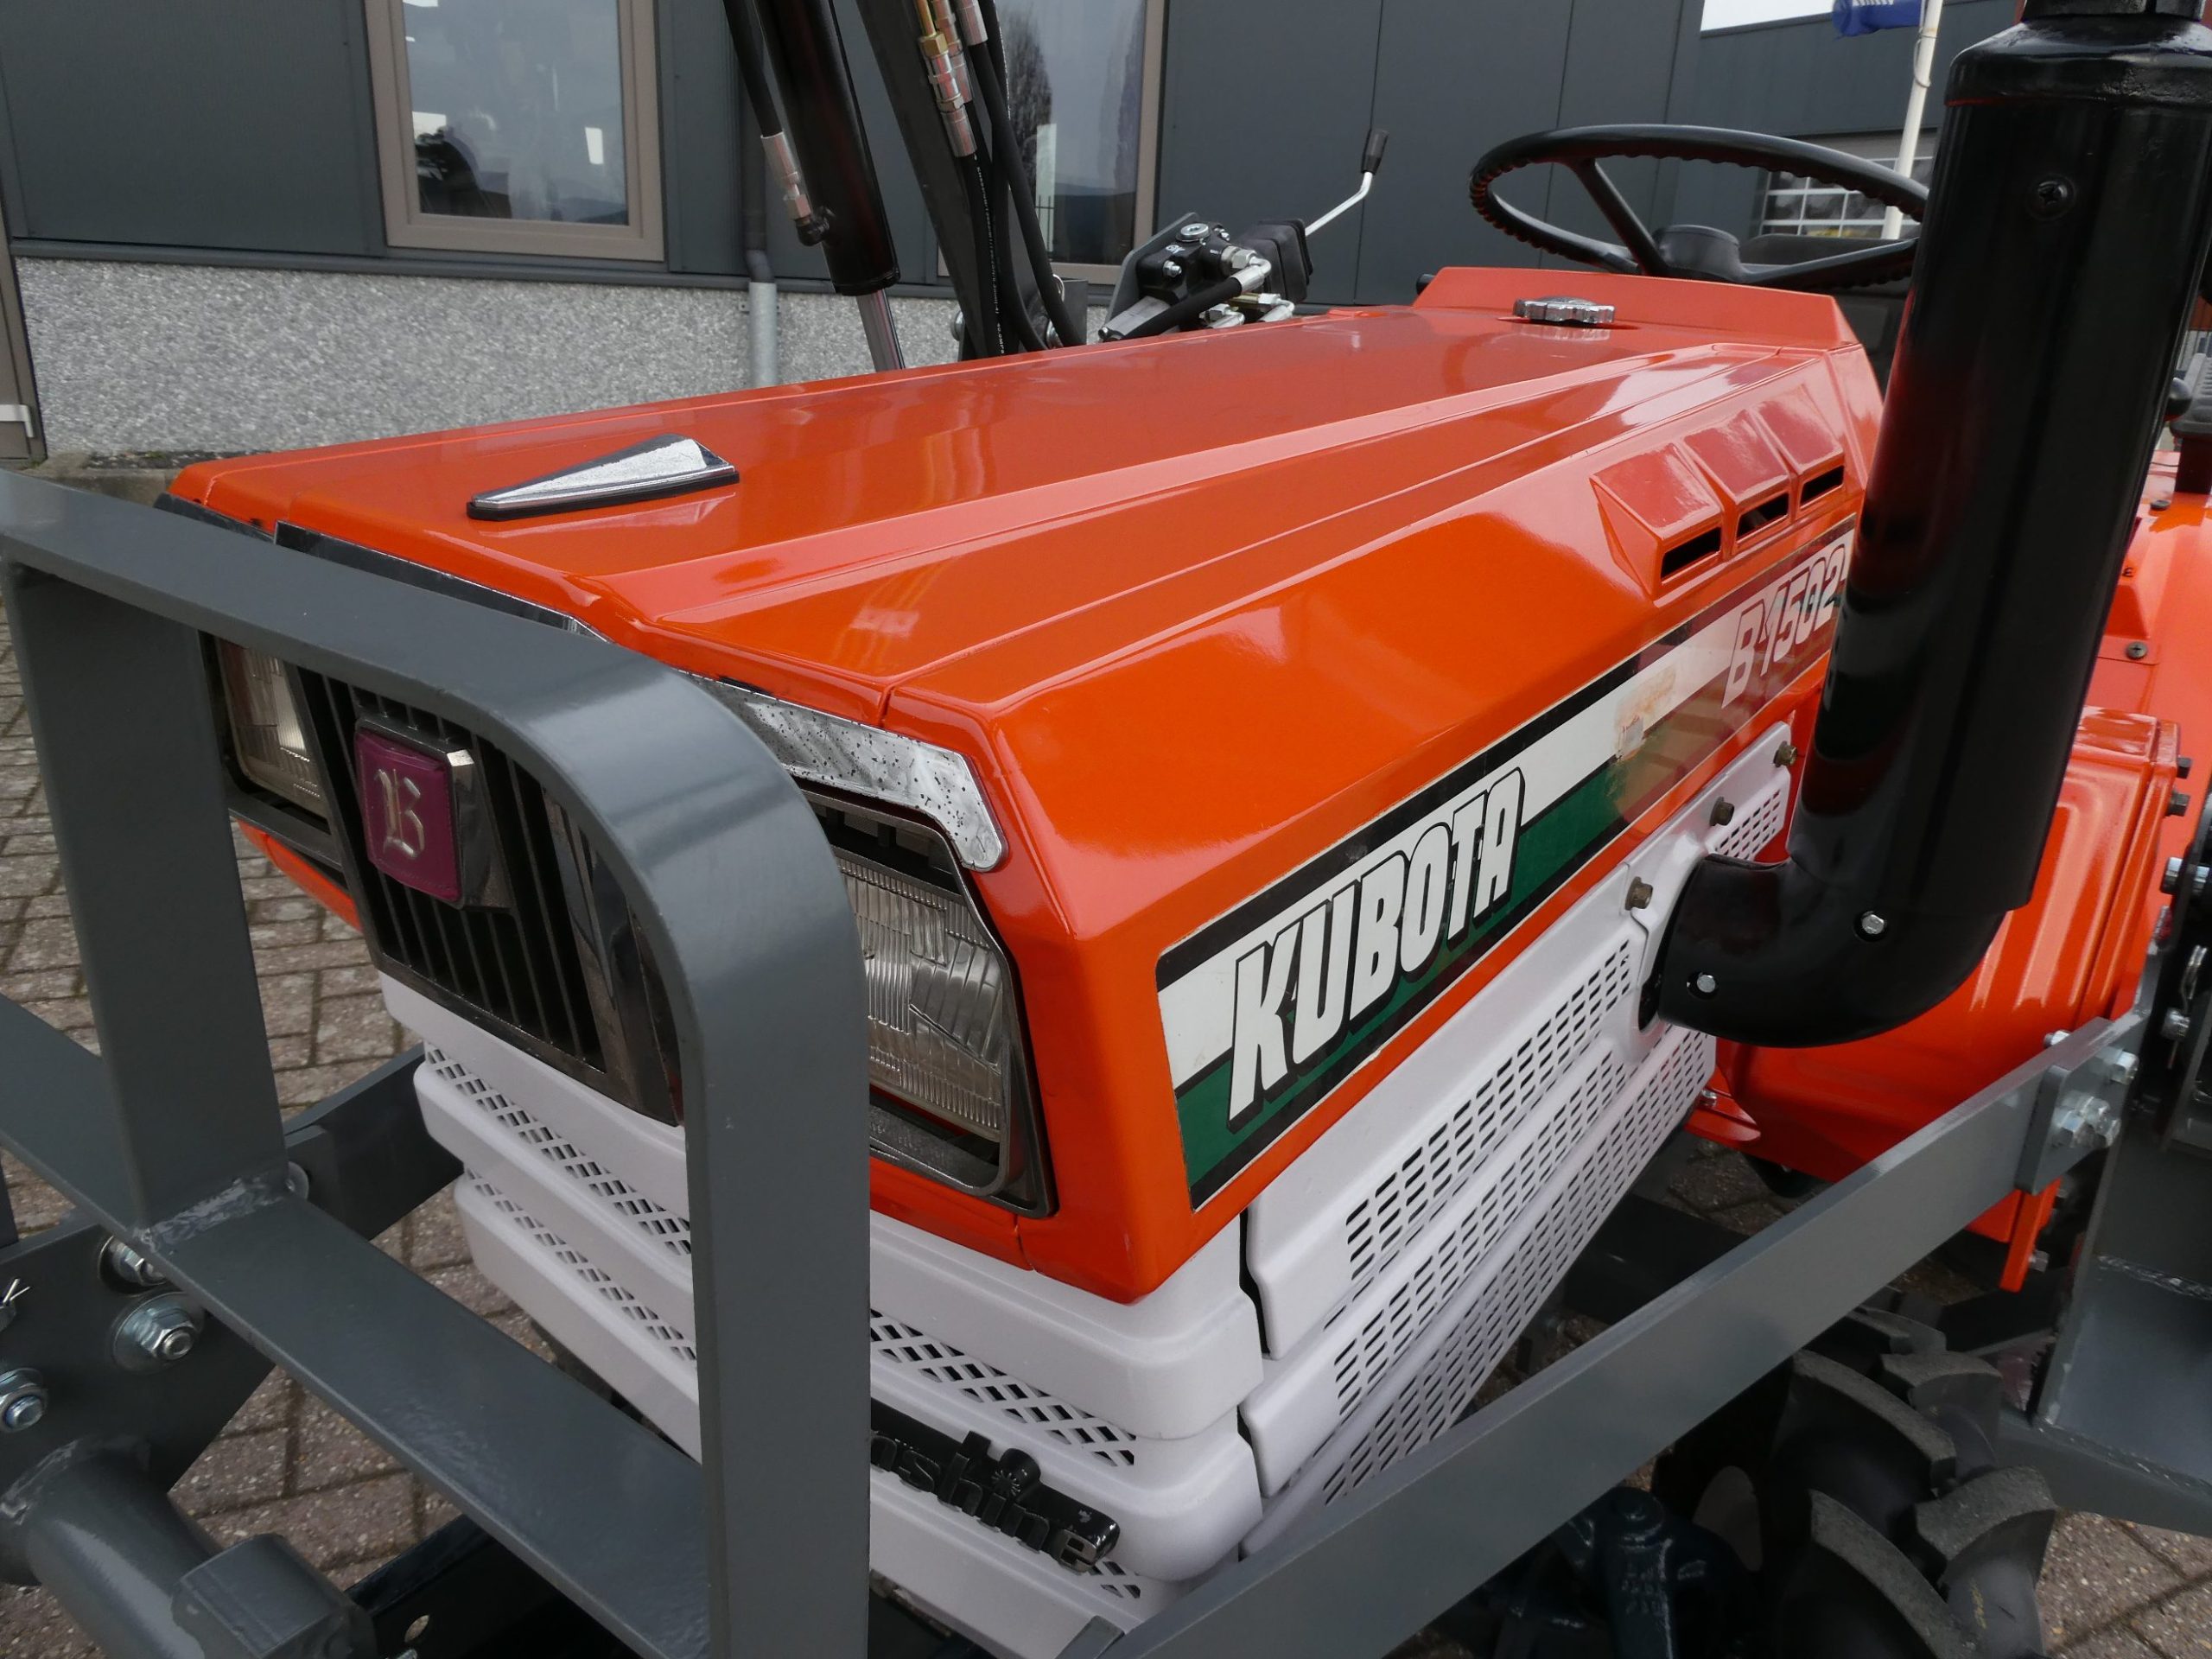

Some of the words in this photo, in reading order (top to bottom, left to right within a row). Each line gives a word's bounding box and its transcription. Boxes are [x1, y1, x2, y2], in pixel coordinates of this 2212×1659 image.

[1721, 543, 1846, 709] B1502
[374, 768, 426, 861] B
[1228, 766, 1525, 1132] KUBOTA
